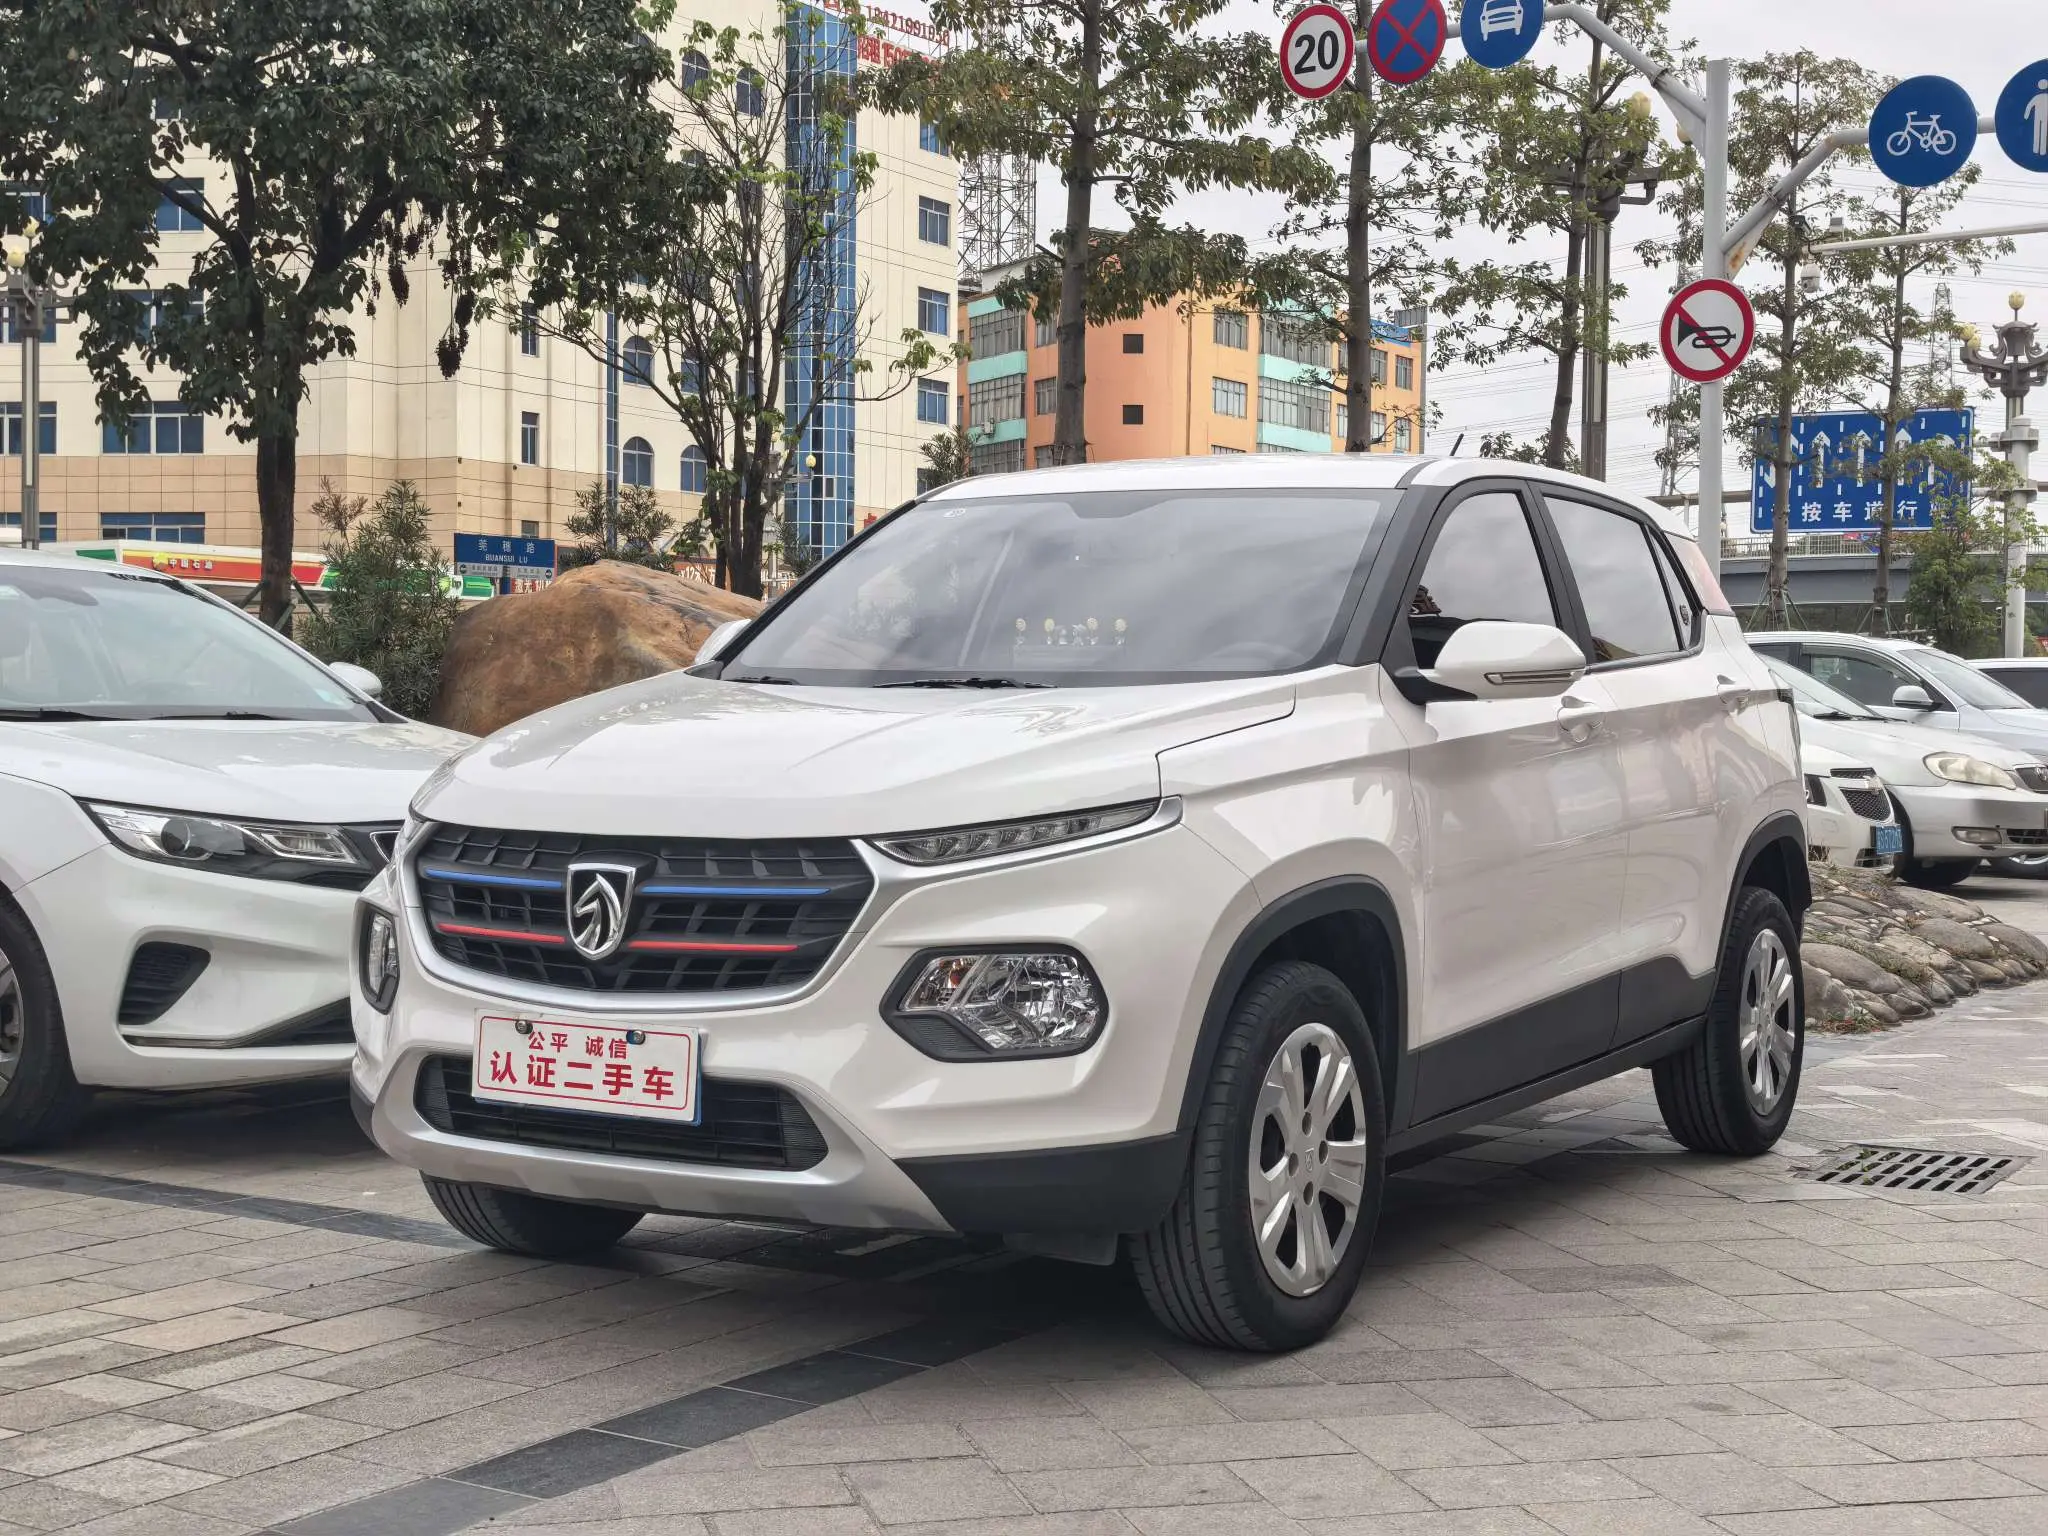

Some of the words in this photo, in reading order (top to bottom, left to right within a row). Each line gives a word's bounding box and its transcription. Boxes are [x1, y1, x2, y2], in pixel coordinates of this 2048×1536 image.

[1293, 30, 1339, 75] 20
[527, 1031, 568, 1053] 公平
[585, 1036, 628, 1060] 诚信
[489, 1050, 674, 1101] 认证二手车
